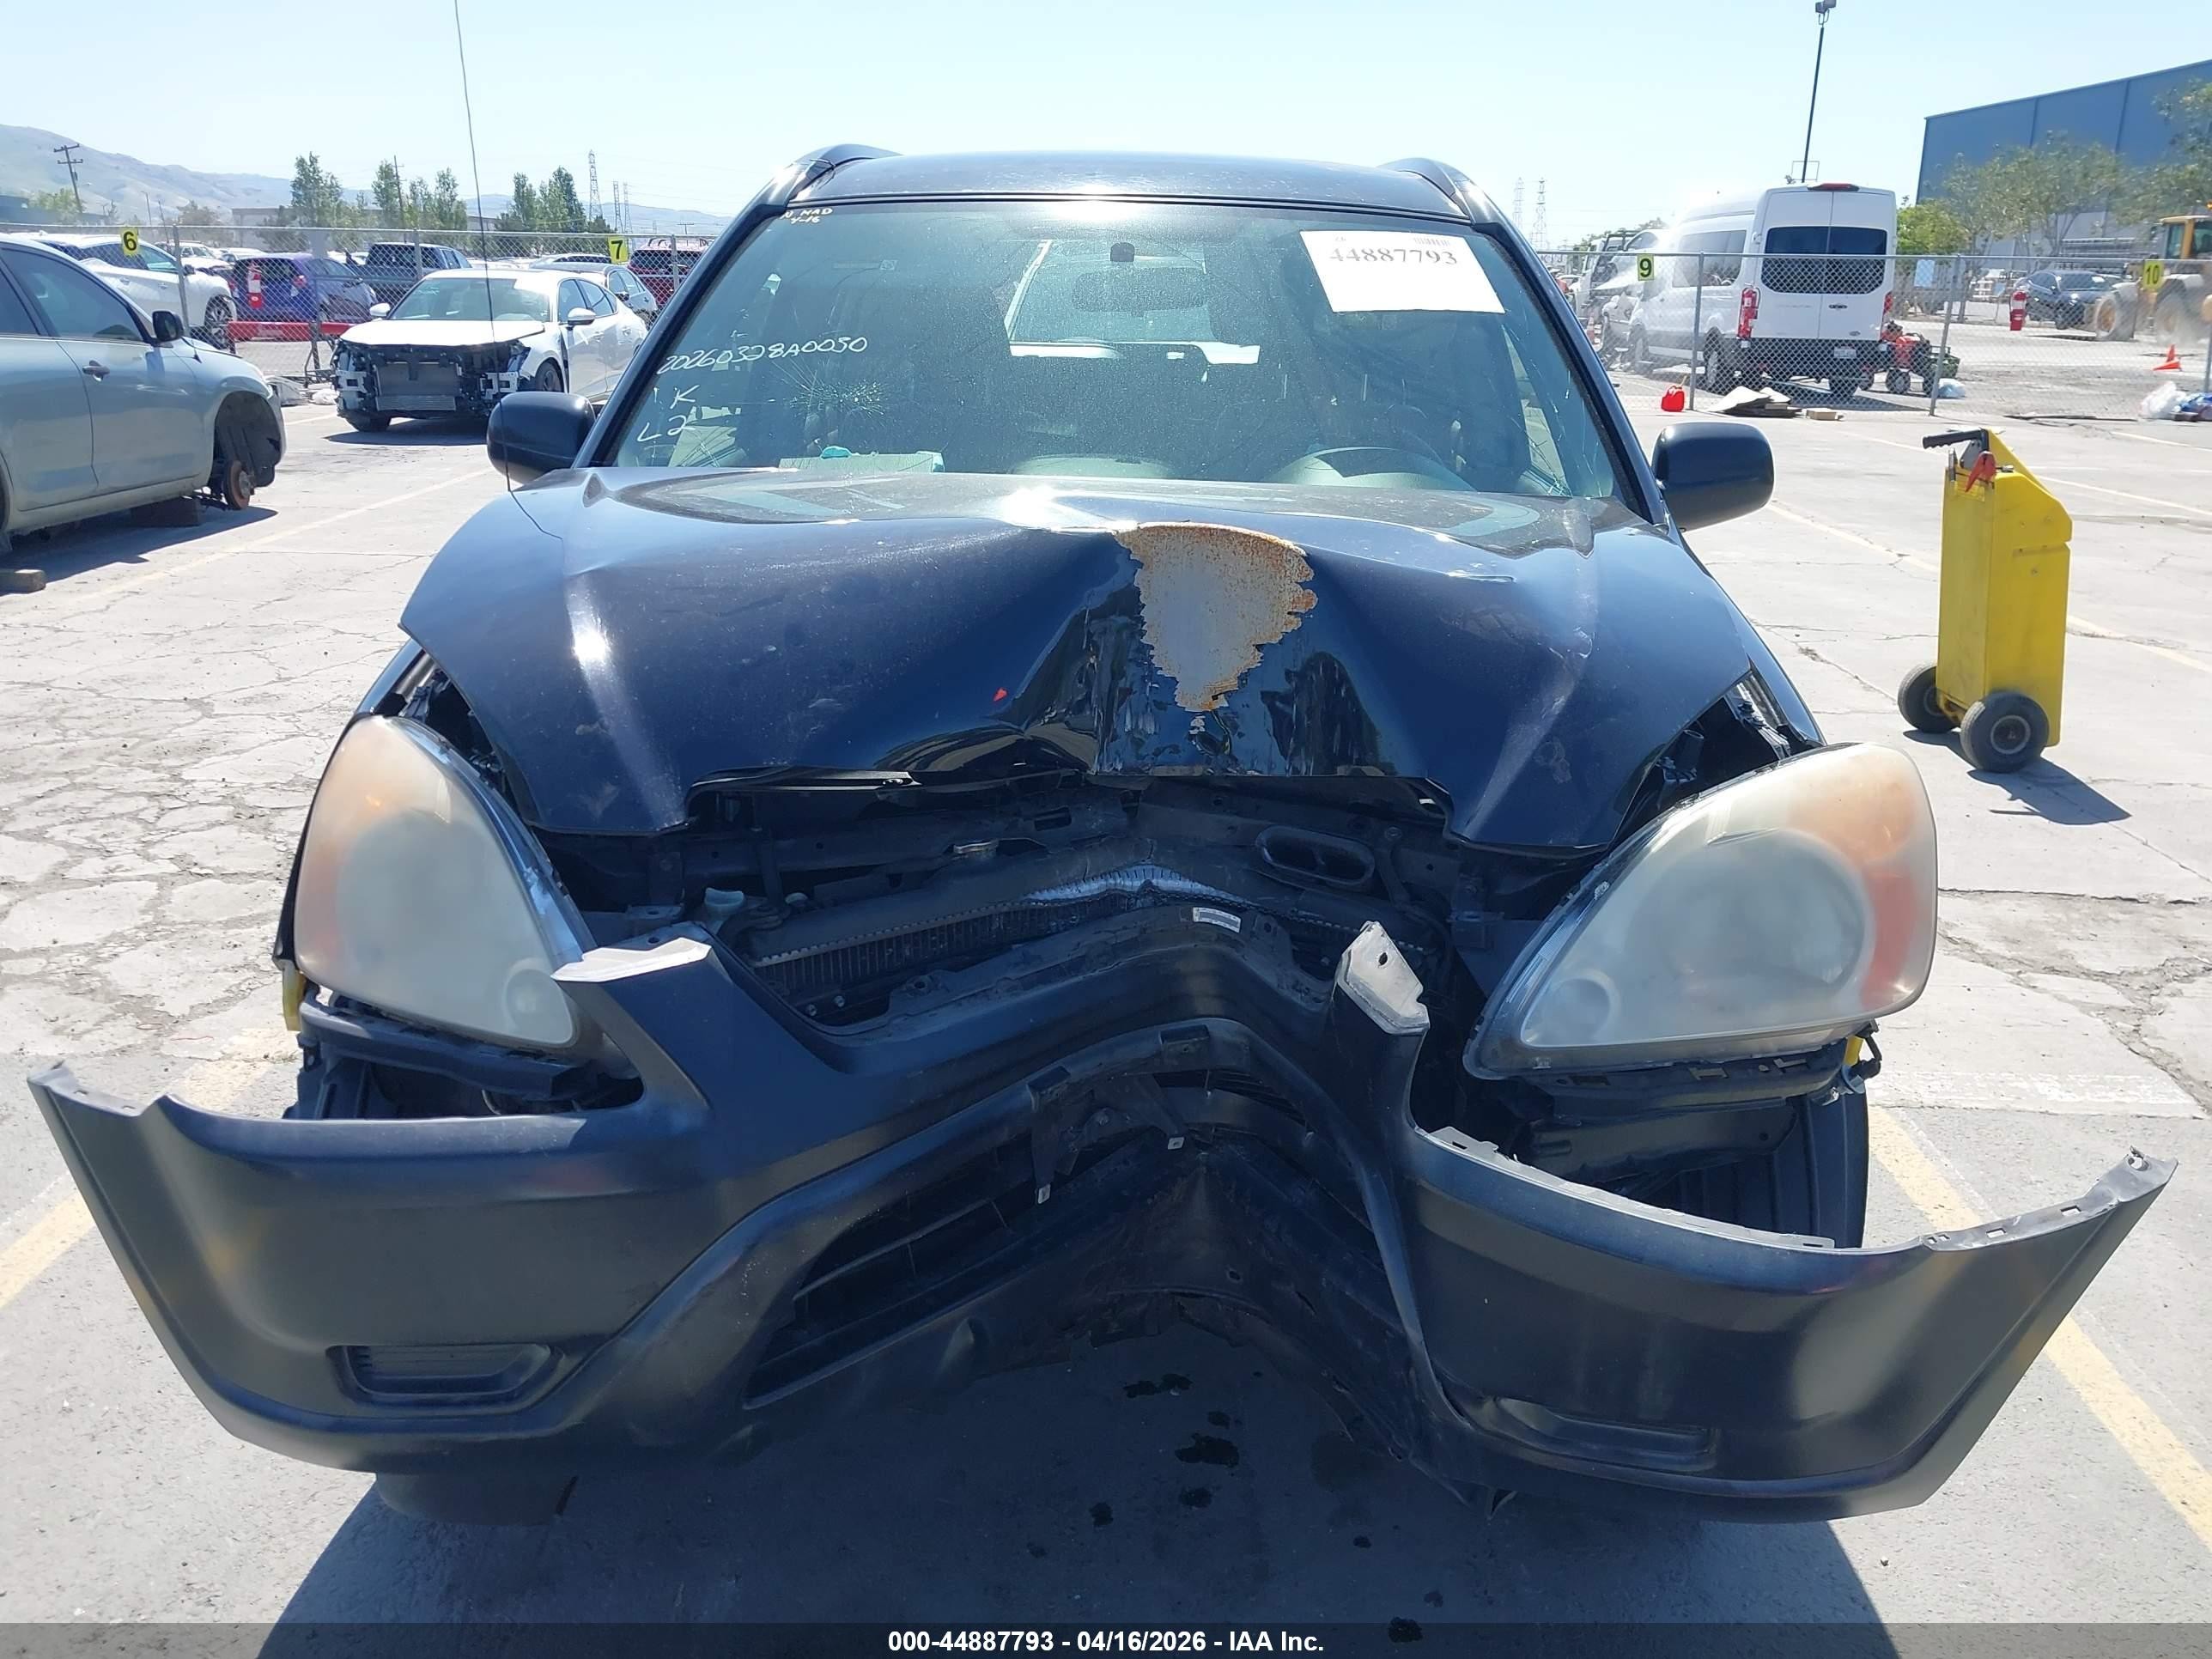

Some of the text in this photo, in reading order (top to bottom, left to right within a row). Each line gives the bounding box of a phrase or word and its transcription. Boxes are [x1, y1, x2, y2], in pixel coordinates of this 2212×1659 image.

[124, 231, 137, 251] 6
[611, 240, 623, 259] 7
[1330, 247, 1457, 265] 44887793
[1639, 258, 1652, 277] 9
[2146, 264, 2160, 284] 10
